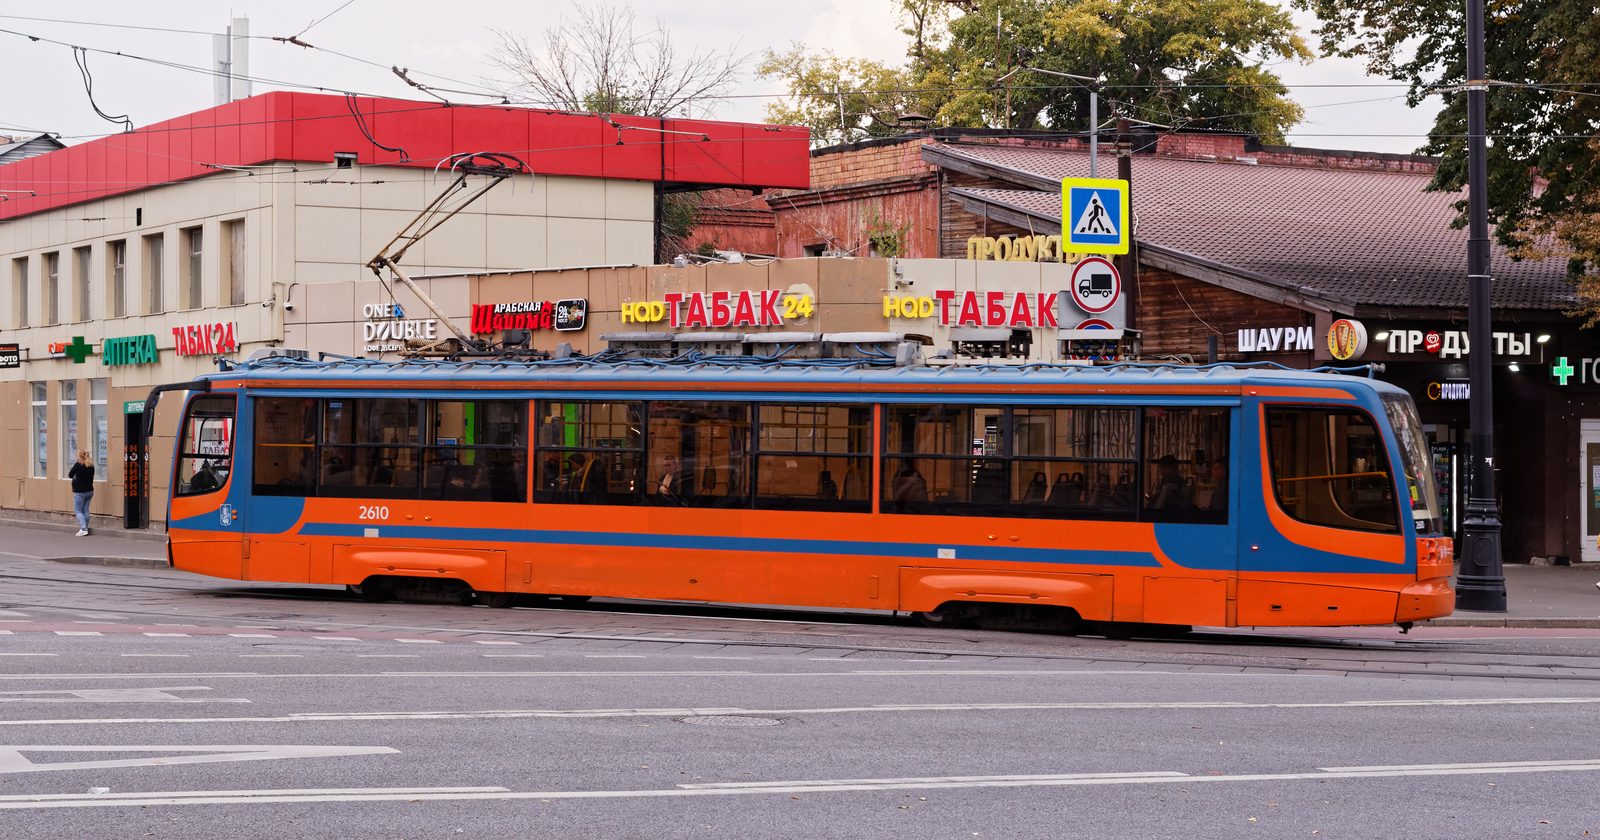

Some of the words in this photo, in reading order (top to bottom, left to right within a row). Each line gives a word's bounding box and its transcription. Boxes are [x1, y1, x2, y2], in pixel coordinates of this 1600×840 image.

[494, 302, 541, 313] АРАБСКАЯ
[558, 306, 568, 318] 24
[621, 302, 665, 323] HQD
[664, 290, 784, 328] ТАБАК
[783, 295, 813, 319] 24
[883, 296, 935, 318] HQD
[935, 290, 1058, 328] ТАБАК
[102, 335, 158, 365] АПТЕКА
[172, 324, 214, 356] ТАБАК
[215, 322, 235, 353] 24
[1238, 326, 1314, 352] ШАУРМ
[1387, 330, 1531, 358] ПРОДУТЫ
[359, 506, 389, 520] 2610
